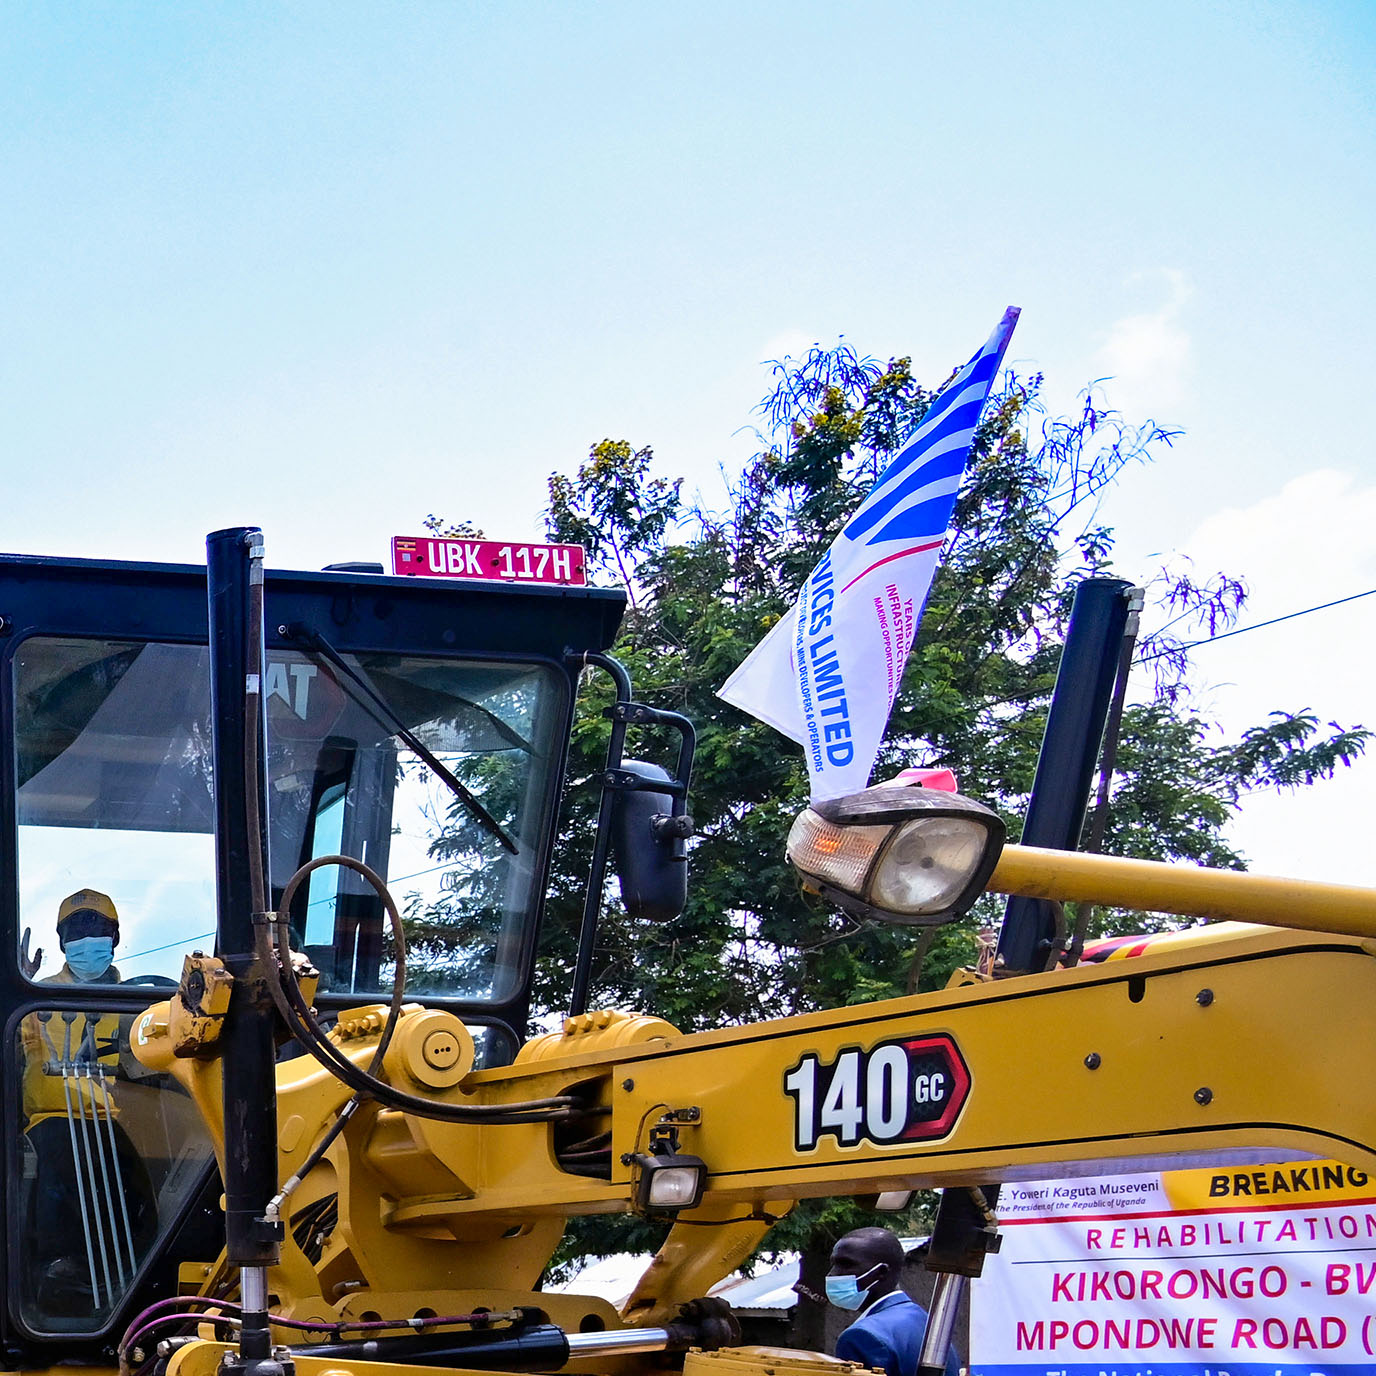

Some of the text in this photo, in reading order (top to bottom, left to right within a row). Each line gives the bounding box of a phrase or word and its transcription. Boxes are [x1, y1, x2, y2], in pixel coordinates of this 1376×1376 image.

[428, 542, 571, 580] UBK 117H
[904, 598, 912, 638] YEARS
[797, 647, 806, 666] MINE
[874, 597, 888, 630] MAKING
[882, 630, 894, 694] OPPORTUNITIES
[799, 666, 814, 713] DEVELOPERS
[810, 634, 854, 767] LIMITED
[808, 721, 824, 773] OPERATORS
[787, 1044, 944, 1145] 140 GC
[1011, 1188, 1049, 1200] Yoweri
[1052, 1186, 1096, 1200] Kaguta
[1099, 1180, 1160, 1195] Museveni
[1209, 1166, 1368, 1197] BREAKING
[1056, 1201, 1069, 1210] the
[1072, 1199, 1106, 1210] Republic
[1107, 1199, 1116, 1208] of
[1116, 1198, 1146, 1208] Uganda
[1052, 1265, 1287, 1302] KIKORONGO
[1016, 1318, 1218, 1351] MPONDWE
[1231, 1316, 1347, 1350] ROAD
